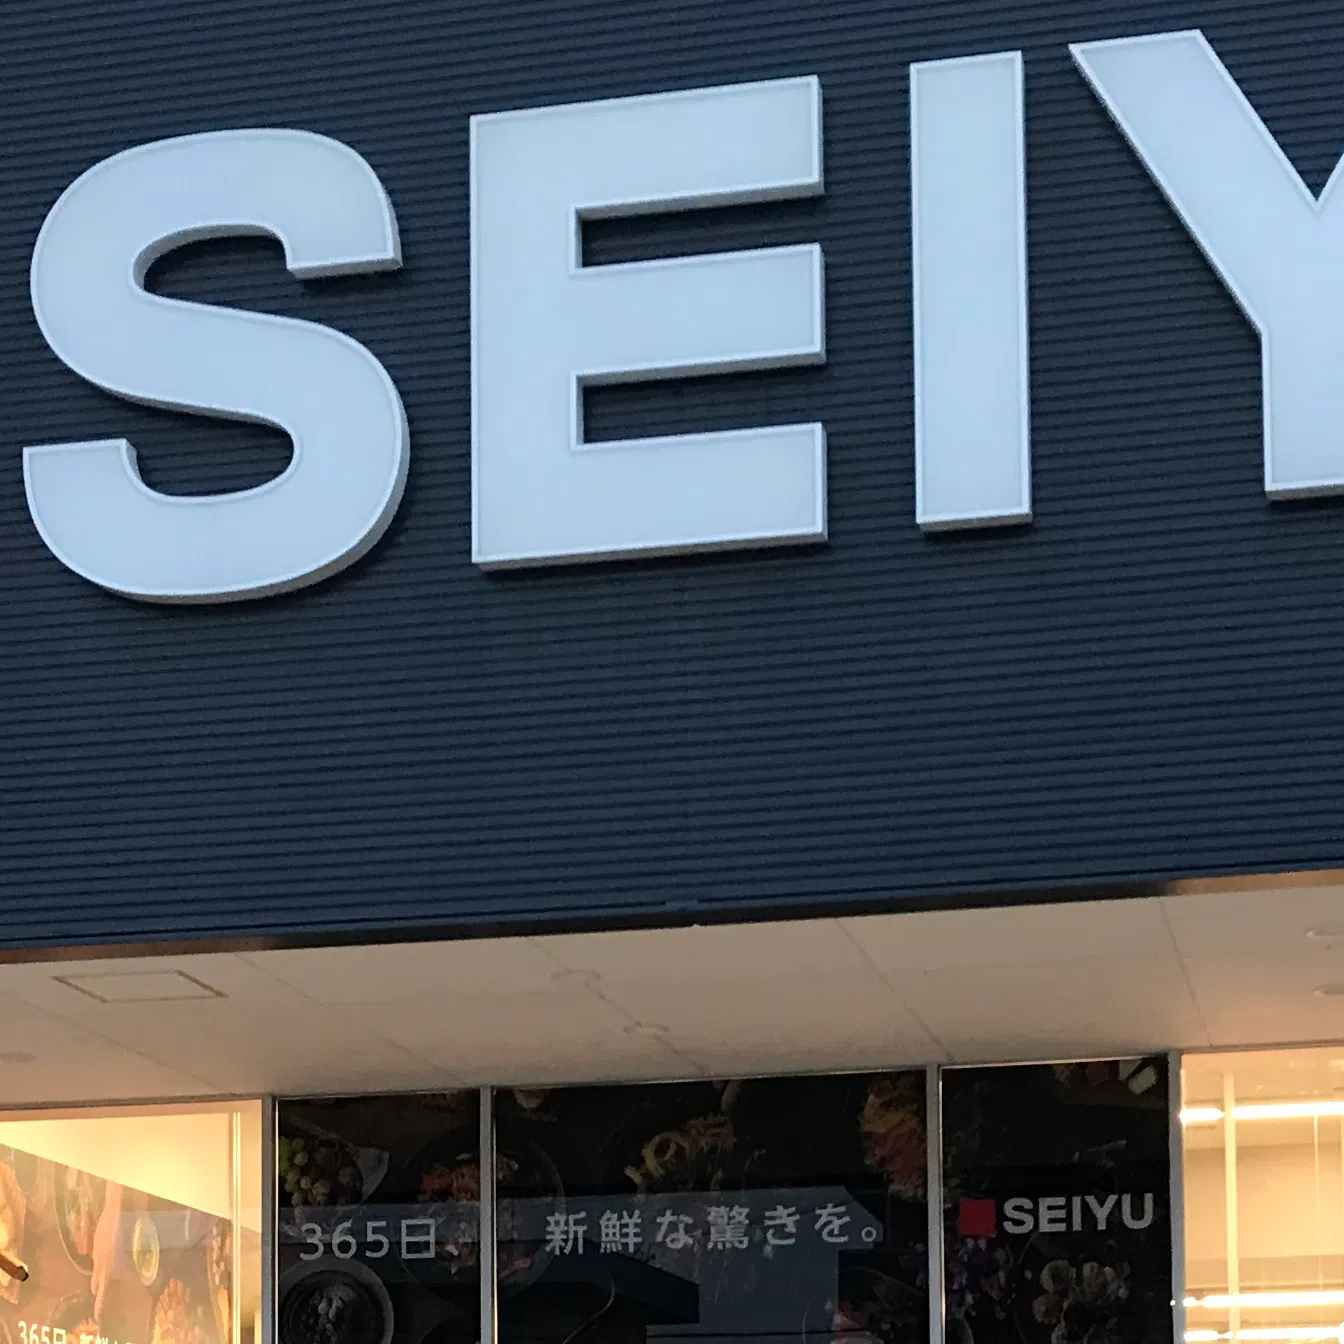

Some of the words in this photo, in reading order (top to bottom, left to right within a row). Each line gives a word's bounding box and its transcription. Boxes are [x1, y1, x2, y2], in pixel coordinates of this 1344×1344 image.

[544, 1203, 878, 1257] 新鮮な驚きを。
[1002, 1193, 1155, 1235] SEIYU
